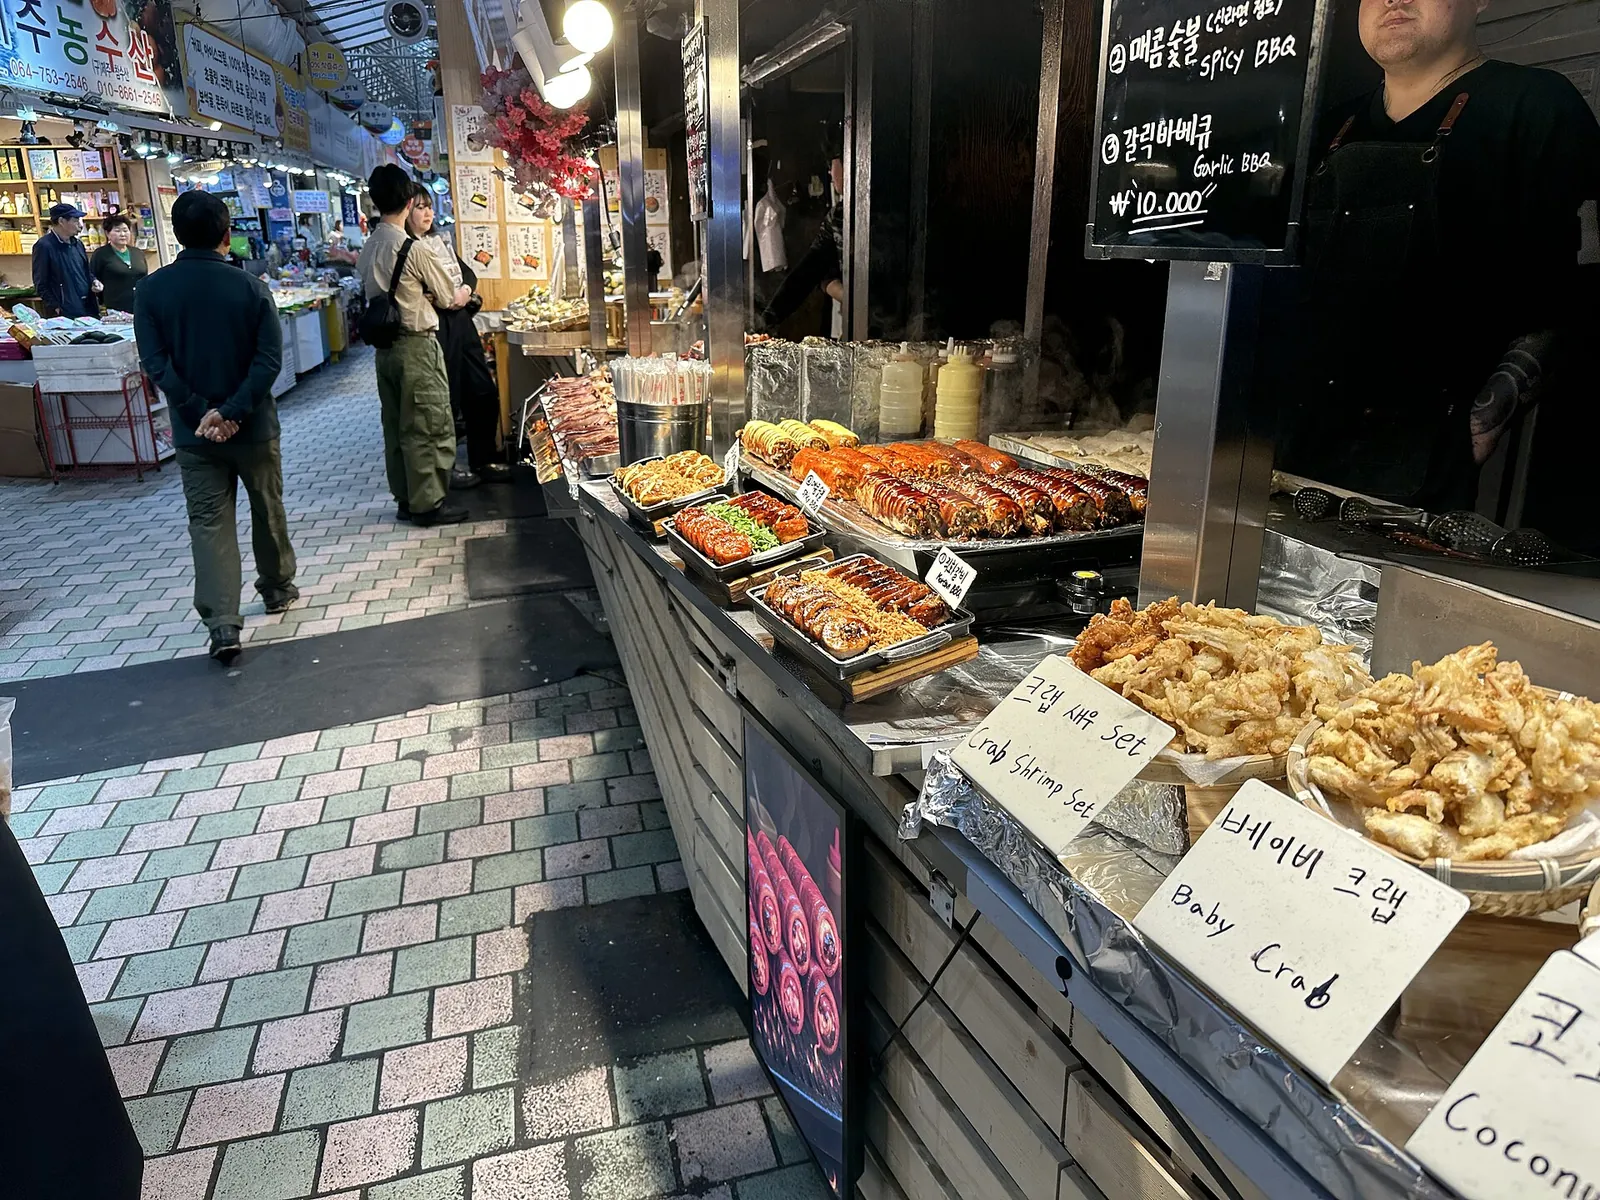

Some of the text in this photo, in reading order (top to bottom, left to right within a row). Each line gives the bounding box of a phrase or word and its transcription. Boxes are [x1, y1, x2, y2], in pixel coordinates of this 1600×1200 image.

[0, 0, 154, 83] 주농수산
[1206, 1, 1250, 34] (신라면
[10, 57, 89, 92] 064-753-2546
[1254, 34, 1296, 68] BBQ
[97, 81, 161, 107] 010-8661-2546
[1123, 113, 1213, 163] 갈릭바베큐
[1193, 152, 1272, 178] Garlic BBQ
[1013, 675, 1065, 713] 크랩
[1063, 703, 1099, 731] 새우
[968, 727, 1096, 819] Crab Shrimp Set
[1219, 807, 1408, 925] 베이비 크랩
[1170, 883, 1340, 1009] Baby Crab
